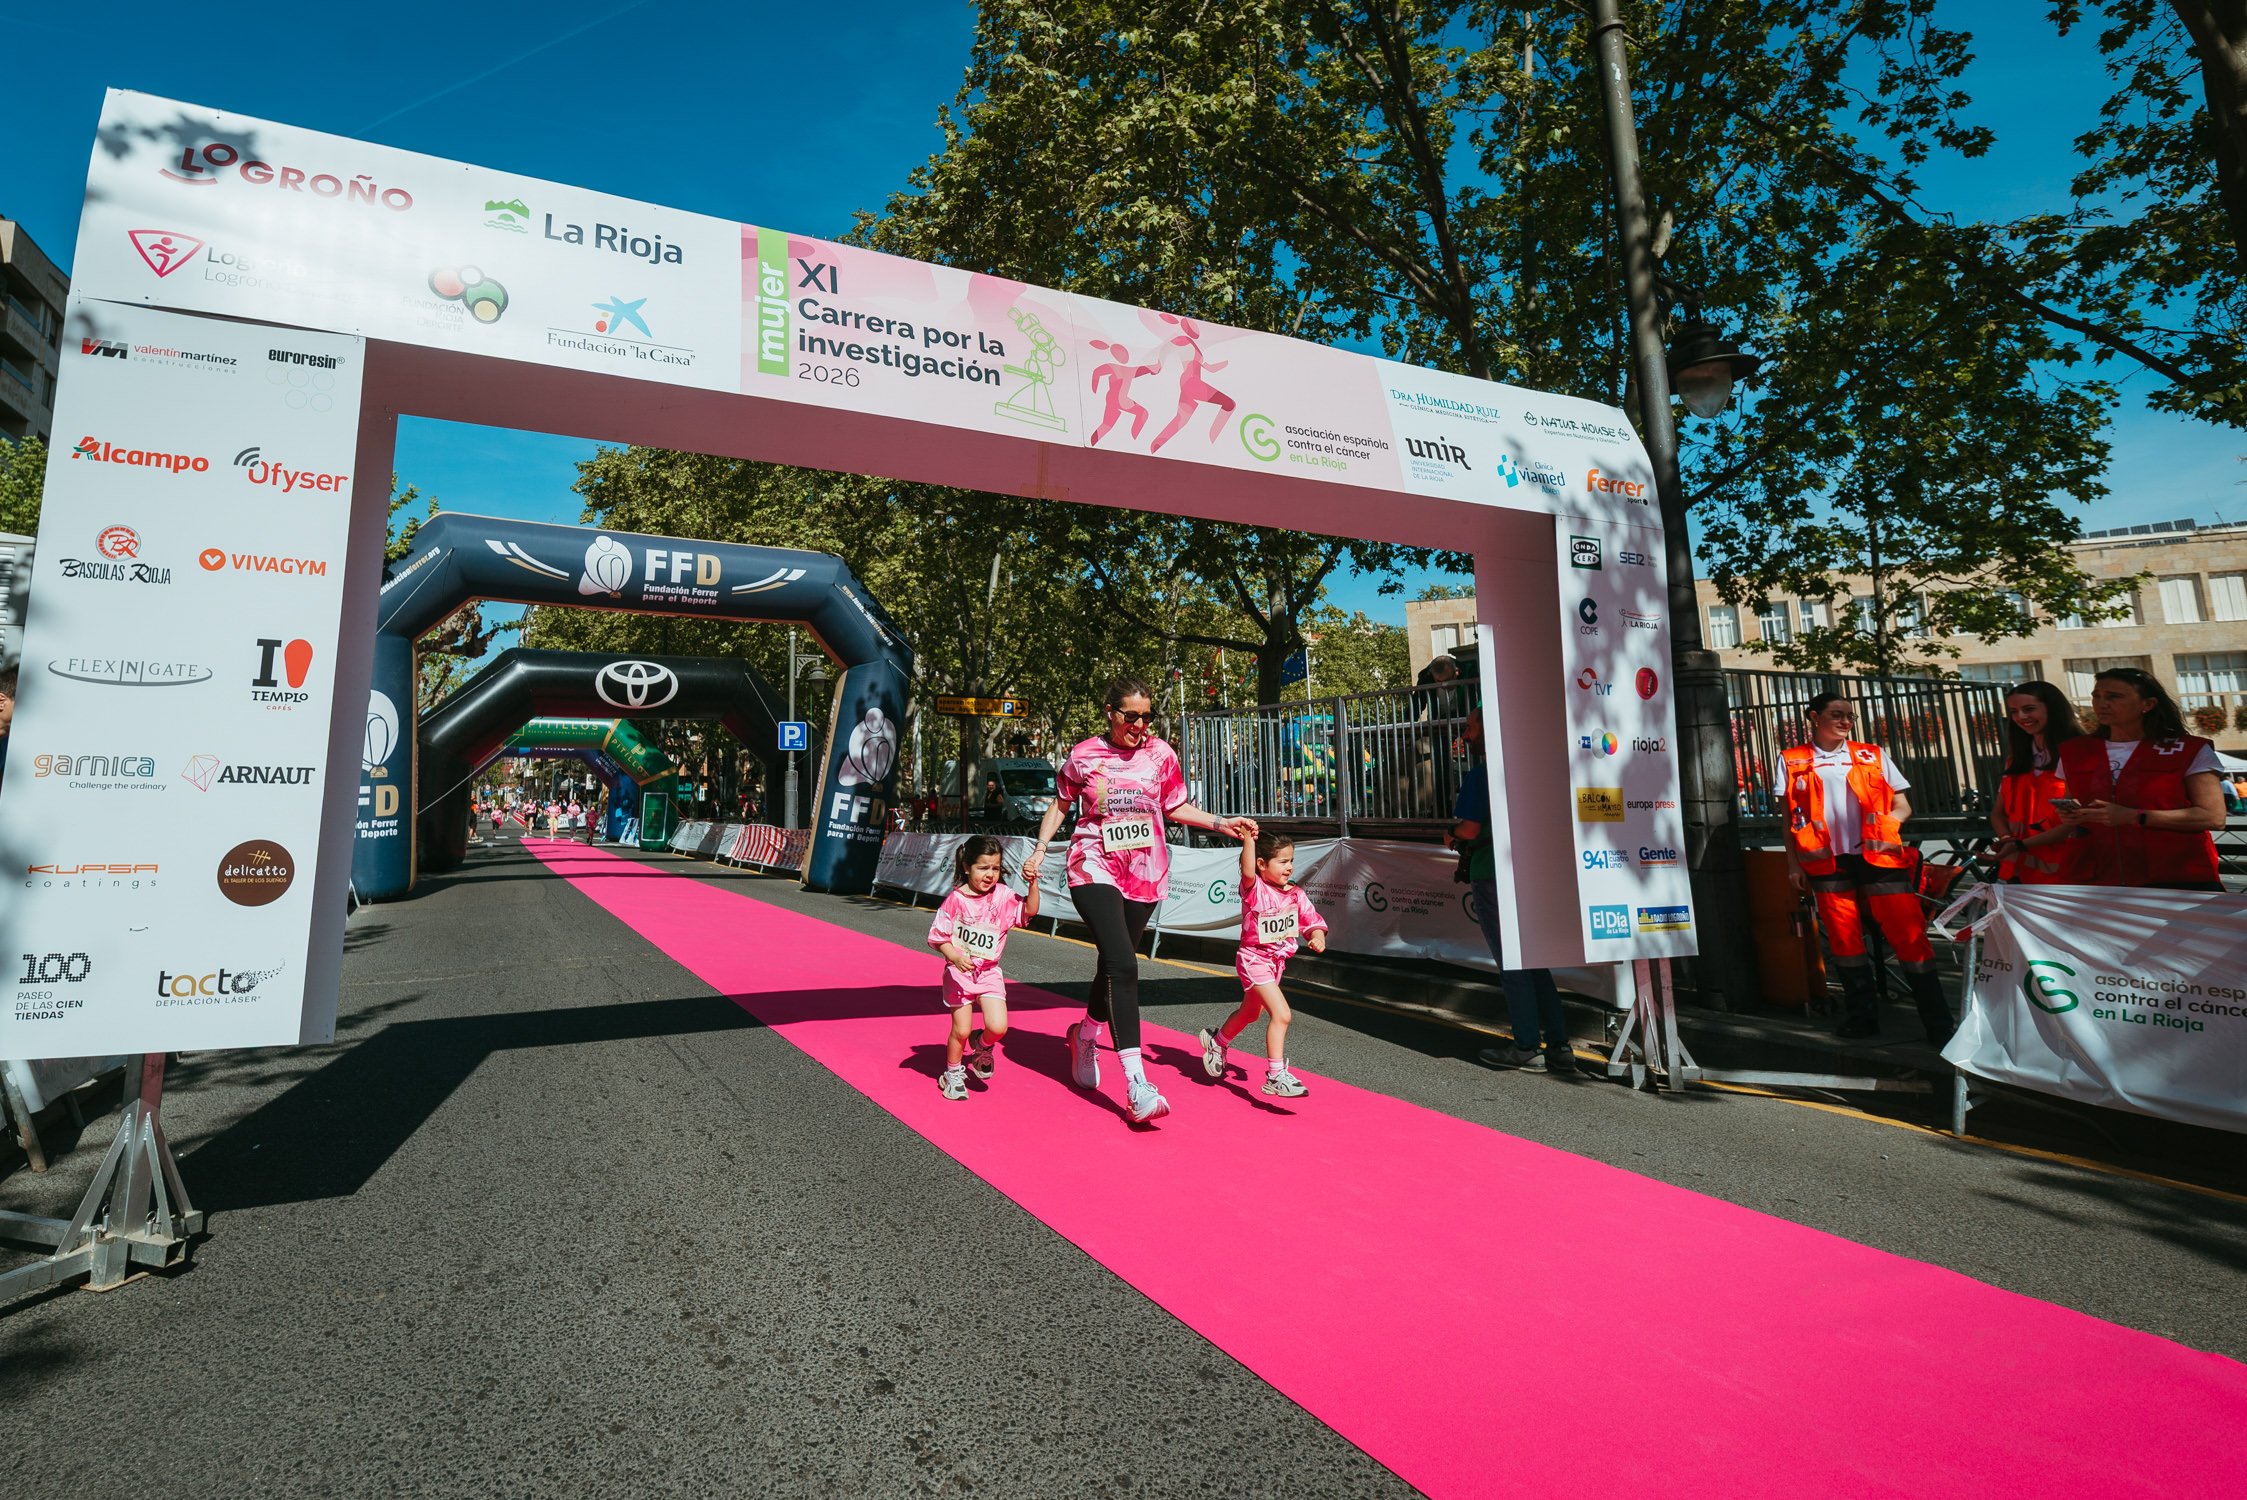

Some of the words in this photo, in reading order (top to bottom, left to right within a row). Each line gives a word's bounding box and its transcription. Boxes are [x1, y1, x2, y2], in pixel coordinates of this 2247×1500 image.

[181, 143, 414, 212] LOGROÑO
[544, 213, 583, 246] La
[594, 223, 683, 265] Rioja
[796, 257, 838, 294] XI
[754, 261, 791, 363] mujer
[798, 298, 915, 340] Carrera
[922, 326, 972, 350] por
[979, 332, 1005, 357] la
[547, 332, 627, 357] Fundación
[798, 328, 1001, 386] investigación
[798, 362, 861, 387] 2026
[1416, 393, 1475, 413] HUMILDAD
[1475, 405, 1501, 418] RUIZ
[1541, 416, 1579, 431] NATUR
[1581, 422, 1616, 438] HOUSE
[1284, 425, 1342, 442] asociación
[1343, 434, 1389, 451] española
[72, 436, 209, 473] Alcampo
[1287, 440, 1322, 452] contra
[1325, 442, 1334, 454] el
[1336, 445, 1371, 461] cáncer
[1290, 453, 1304, 463] en
[1306, 452, 1319, 465] La
[1321, 454, 1347, 471] Rioja
[1518, 467, 1566, 486] viamed
[1627, 497, 1643, 505] sport
[1573, 543, 1599, 552] ONDA
[129, 561, 171, 585] RIOJA
[230, 553, 327, 576] VIVAGYM
[645, 549, 721, 586] FFD
[643, 583, 690, 595] Fundación
[692, 587, 719, 597] Ferrer
[681, 595, 717, 605] Deporte
[1580, 626, 1598, 635] COPE
[251, 690, 309, 703] TEMPLO
[1594, 680, 1612, 695] tvr
[1004, 702, 1013, 714] P
[784, 725, 801, 747] P
[1632, 736, 1666, 754] rioja2
[33, 754, 155, 778] garnica
[217, 765, 315, 785] ARNAUT
[69, 781, 114, 791] Challenge
[115, 781, 128, 790] the
[130, 781, 167, 792] ordinary
[1107, 787, 1142, 795] Carrera
[830, 792, 886, 826] FFD
[1107, 798, 1123, 806] por
[1627, 800, 1654, 811] europa
[1655, 800, 1676, 811] press
[361, 828, 399, 840] Deporte
[371, 819, 399, 830] Ferrer
[828, 821, 864, 833] Fundación
[1106, 823, 1150, 842] 10196
[827, 830, 844, 839] para
[1583, 850, 1609, 870] 941
[1639, 847, 1677, 861] Gente
[27, 863, 158, 875] KUPSA
[224, 864, 287, 877] delicatto
[25, 877, 157, 890] coatings
[1177, 887, 1197, 895] cáncer
[1391, 887, 1425, 897] asociación
[1425, 890, 1456, 900] española
[1391, 896, 1412, 904] contra
[1413, 897, 1419, 905] el
[1421, 898, 1445, 907] cáncer
[1411, 906, 1429, 915] Rioja
[1592, 910, 1605, 929] El
[1605, 911, 1628, 928] Día
[957, 926, 994, 950] 10203
[19, 952, 92, 984] 100
[157, 968, 262, 998] tacto
[2095, 974, 2201, 996] asociación
[15, 1001, 29, 1010] DE
[32, 1000, 53, 1010] LAS
[55, 999, 83, 1009] CIEN
[17, 991, 53, 1000] PASEO
[156, 997, 221, 1007] DEPILACIÓN
[2094, 991, 2158, 1008] contra
[2164, 996, 2181, 1010] el
[14, 1011, 64, 1021] TIENDAS
[2093, 1009, 2116, 1021] en
[2122, 1009, 2146, 1025] La
[2153, 1013, 2204, 1032] Rioja
